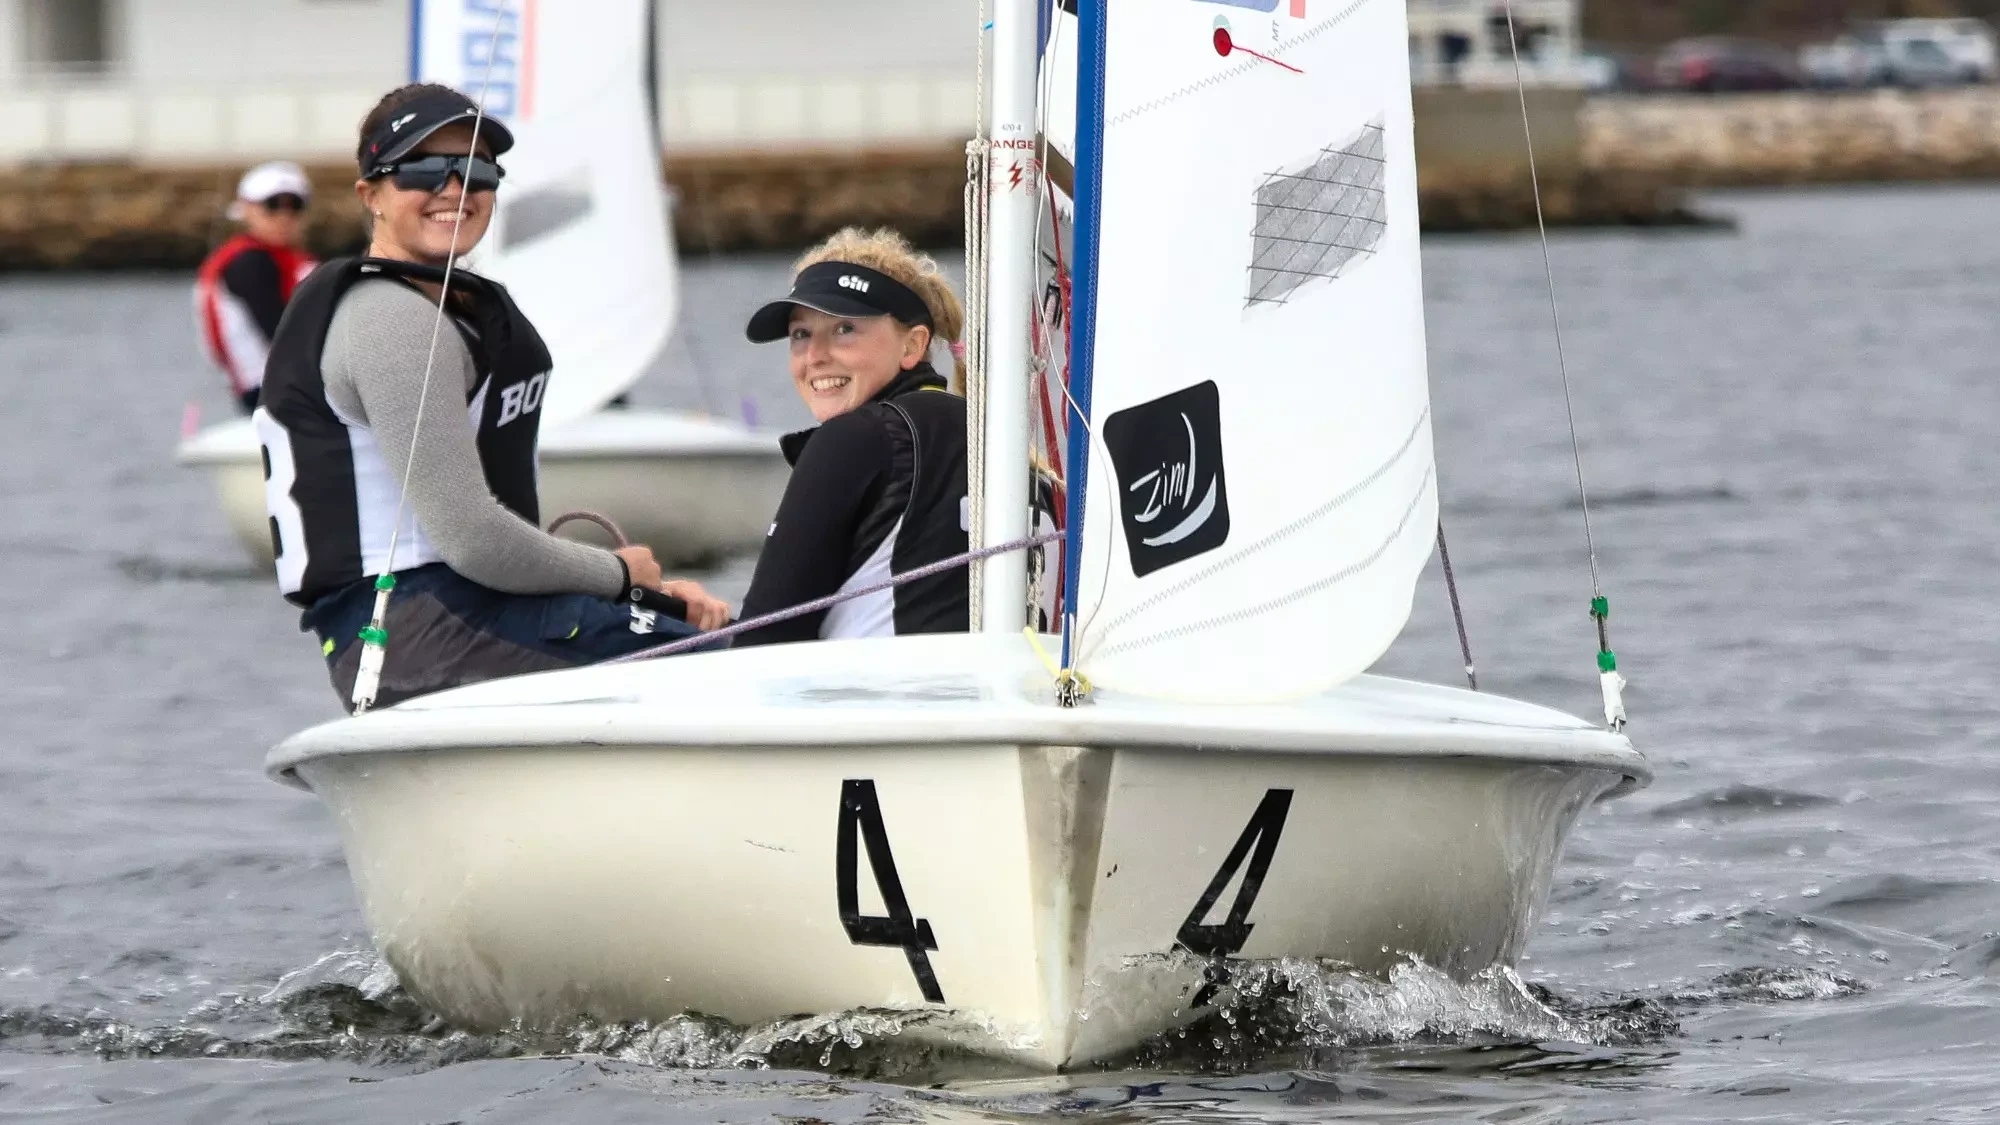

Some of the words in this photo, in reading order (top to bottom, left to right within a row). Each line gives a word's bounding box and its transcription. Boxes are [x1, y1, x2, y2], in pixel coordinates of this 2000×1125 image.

[989, 139, 1034, 150] ANGE
[838, 275, 869, 293] Gill
[836, 779, 946, 1005] 4
[1175, 788, 1295, 1008] 4
